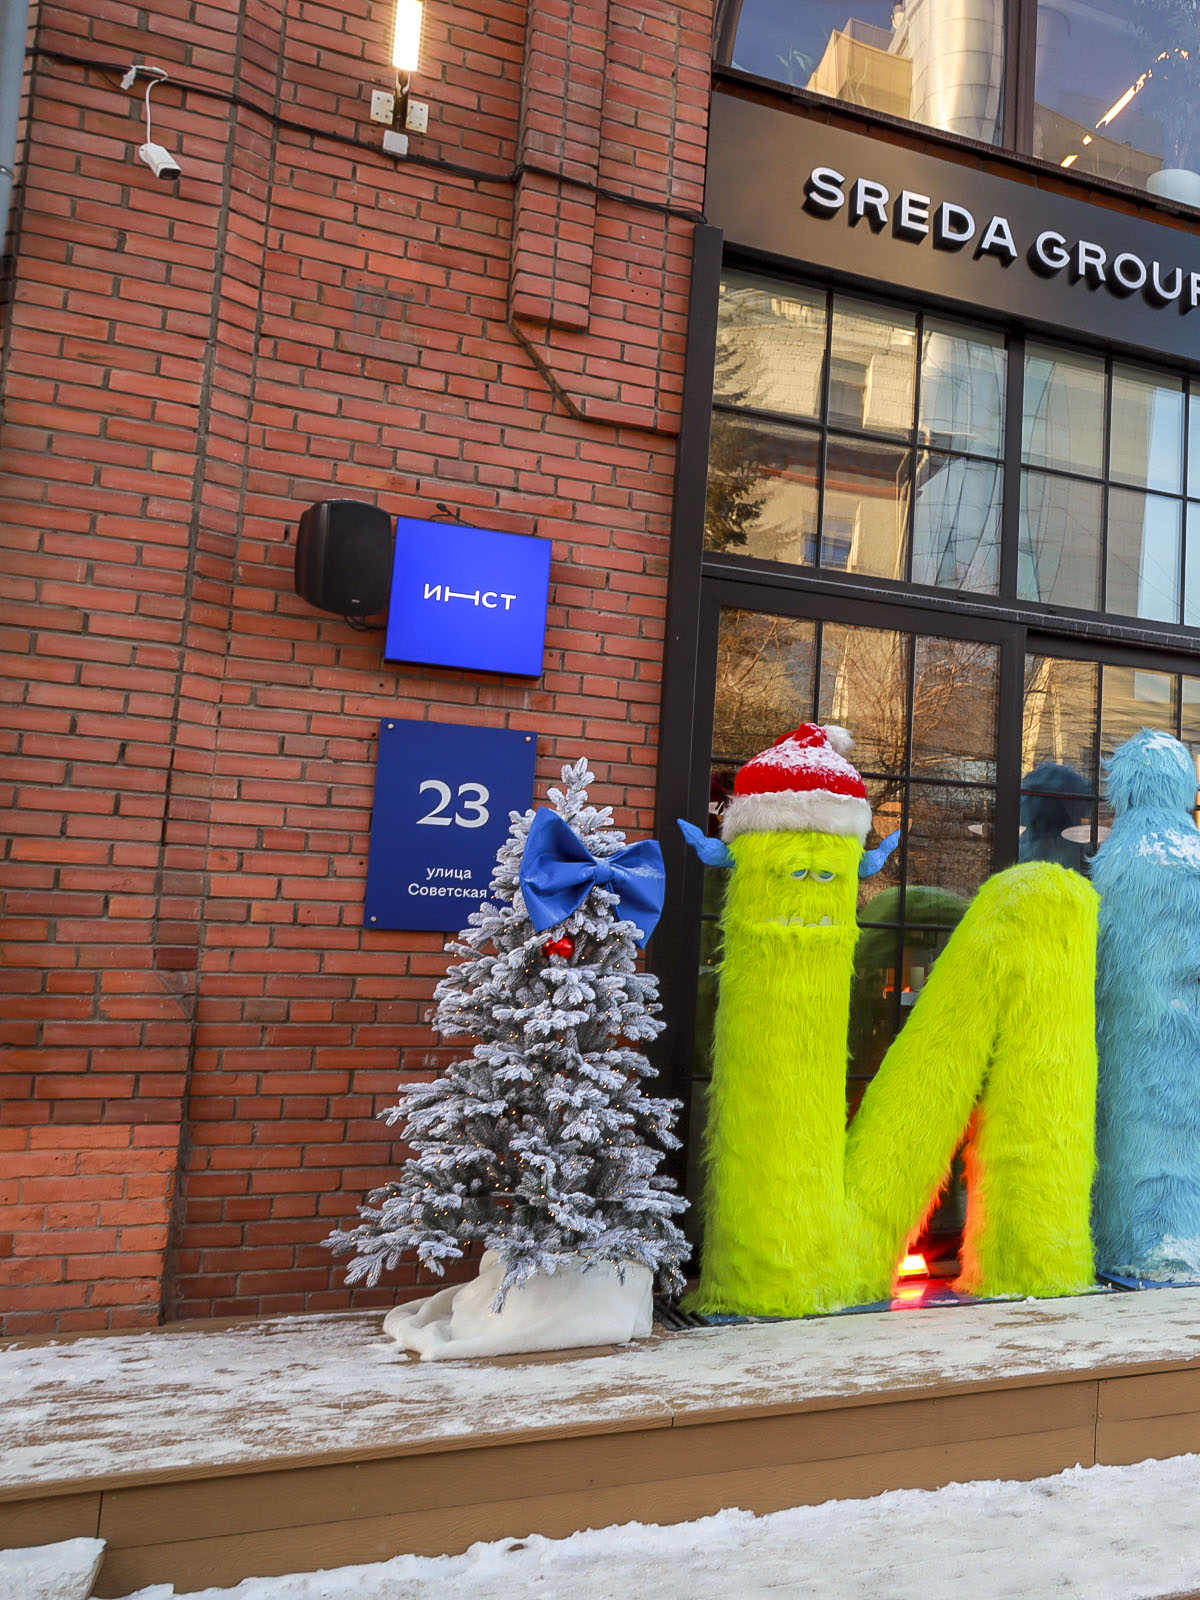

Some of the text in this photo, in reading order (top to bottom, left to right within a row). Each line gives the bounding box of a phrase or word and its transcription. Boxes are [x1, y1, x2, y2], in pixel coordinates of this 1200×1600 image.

[808, 166, 1018, 258] SREDA
[423, 583, 517, 610] ИНСТ
[416, 779, 490, 829] 23
[426, 866, 473, 881] улица
[407, 883, 488, 899] Советская
